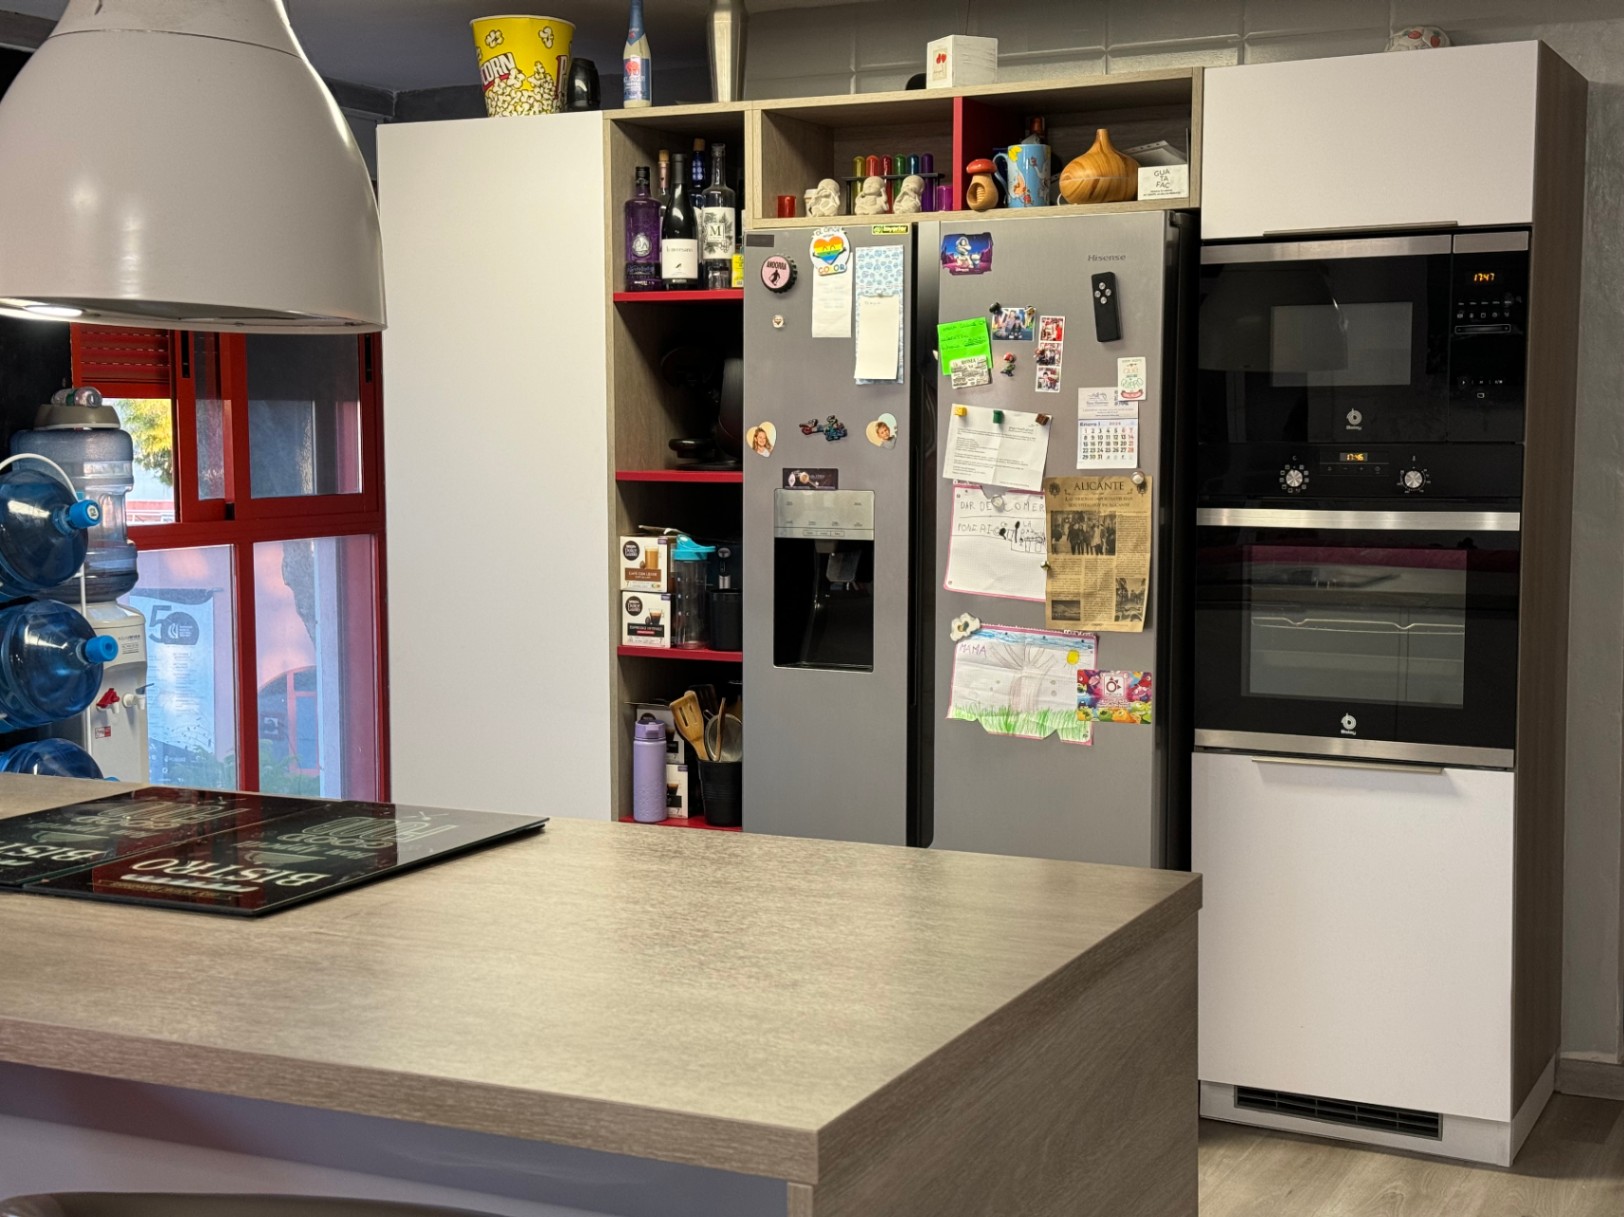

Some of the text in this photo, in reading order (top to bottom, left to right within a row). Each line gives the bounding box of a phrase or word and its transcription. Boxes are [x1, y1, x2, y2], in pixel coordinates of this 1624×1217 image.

[1154, 169, 1170, 177] GUA
[709, 226, 721, 237] M
[1087, 254, 1126, 262] Hisense
[1074, 481, 1124, 491] ALICANTE
[980, 501, 992, 511] DE
[130, 858, 332, 887] BISTRO
